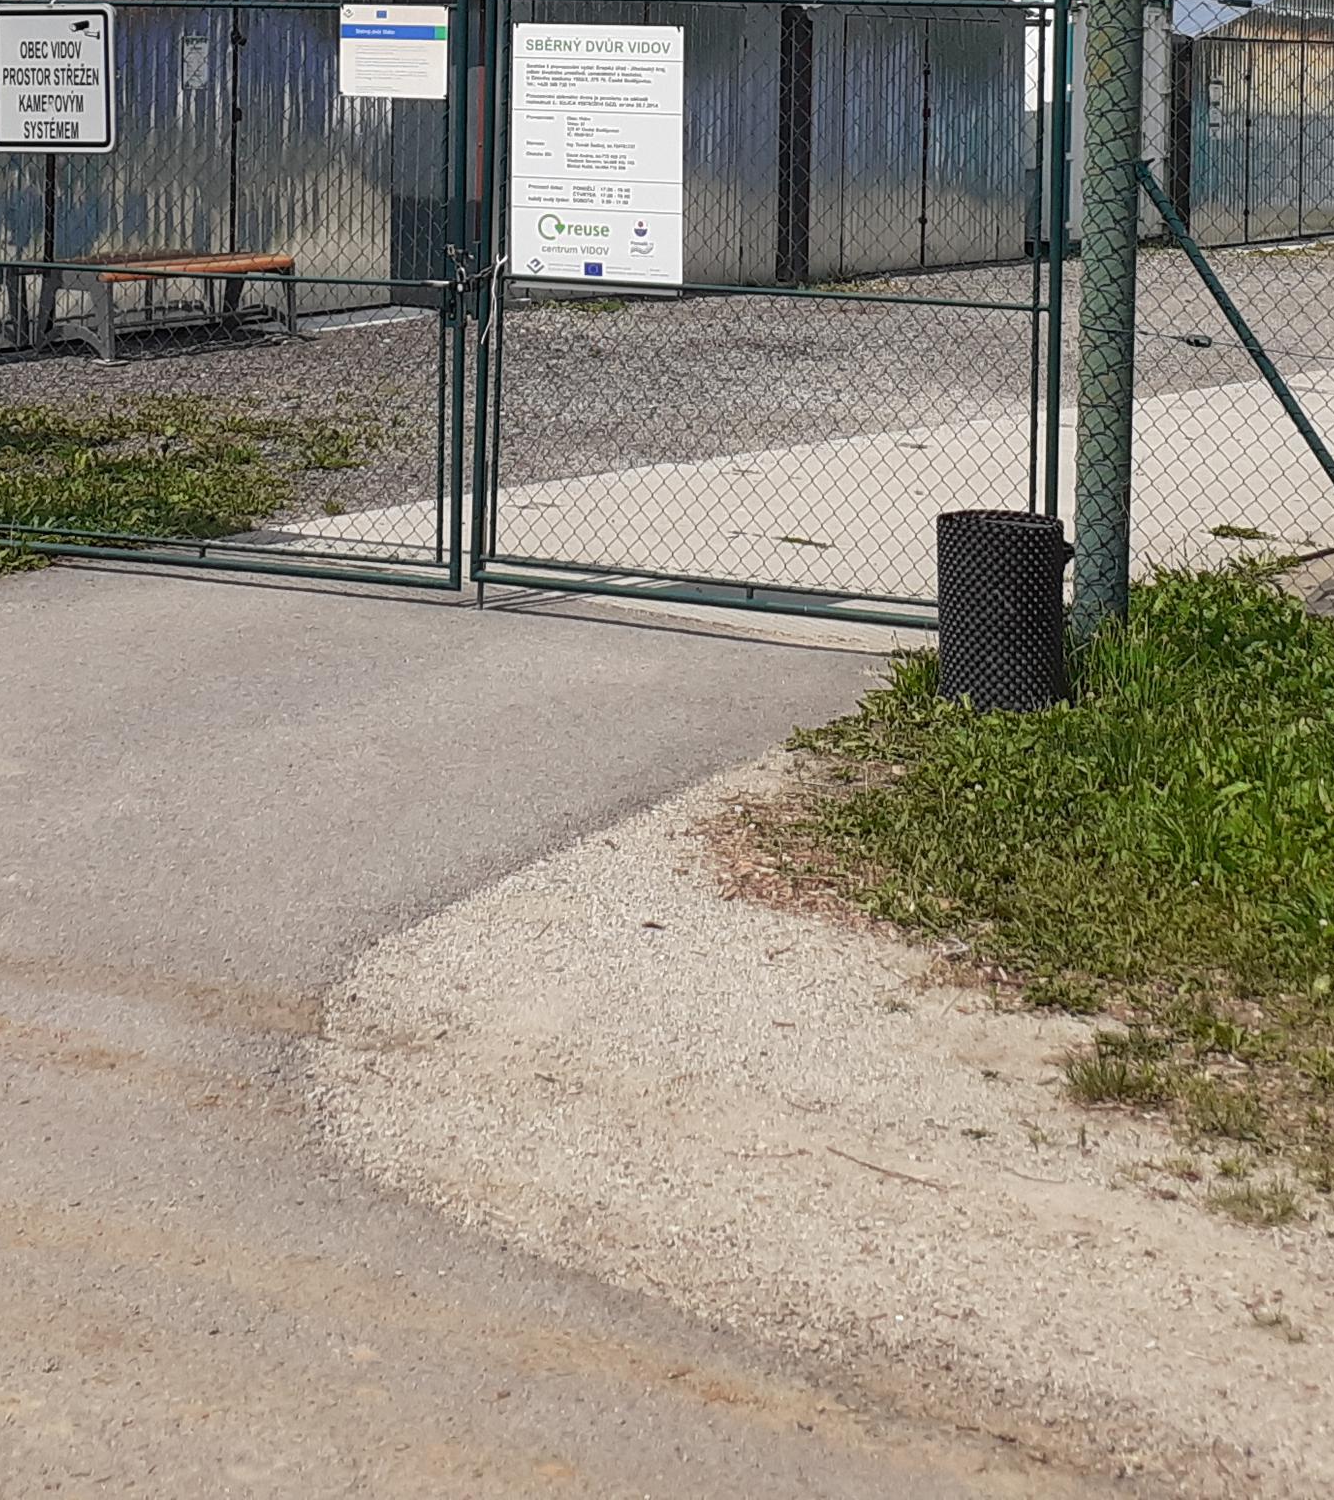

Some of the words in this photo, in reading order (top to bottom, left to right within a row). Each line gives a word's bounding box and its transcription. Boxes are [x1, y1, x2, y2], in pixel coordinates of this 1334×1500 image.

[20, 41, 49, 59] OBEC
[50, 41, 82, 59] VIDOV
[525, 36, 582, 52] SBĚRNÝ
[585, 38, 624, 53] DVŮR
[627, 41, 671, 54] VIDOV
[3, 68, 52, 86] PROSTOR
[54, 63, 100, 86] STŘEŽEN
[24, 117, 80, 139] SYSTÉMEM
[567, 224, 610, 237] reuse
[541, 245, 578, 254] centrum
[580, 246, 610, 256] VIDOV
